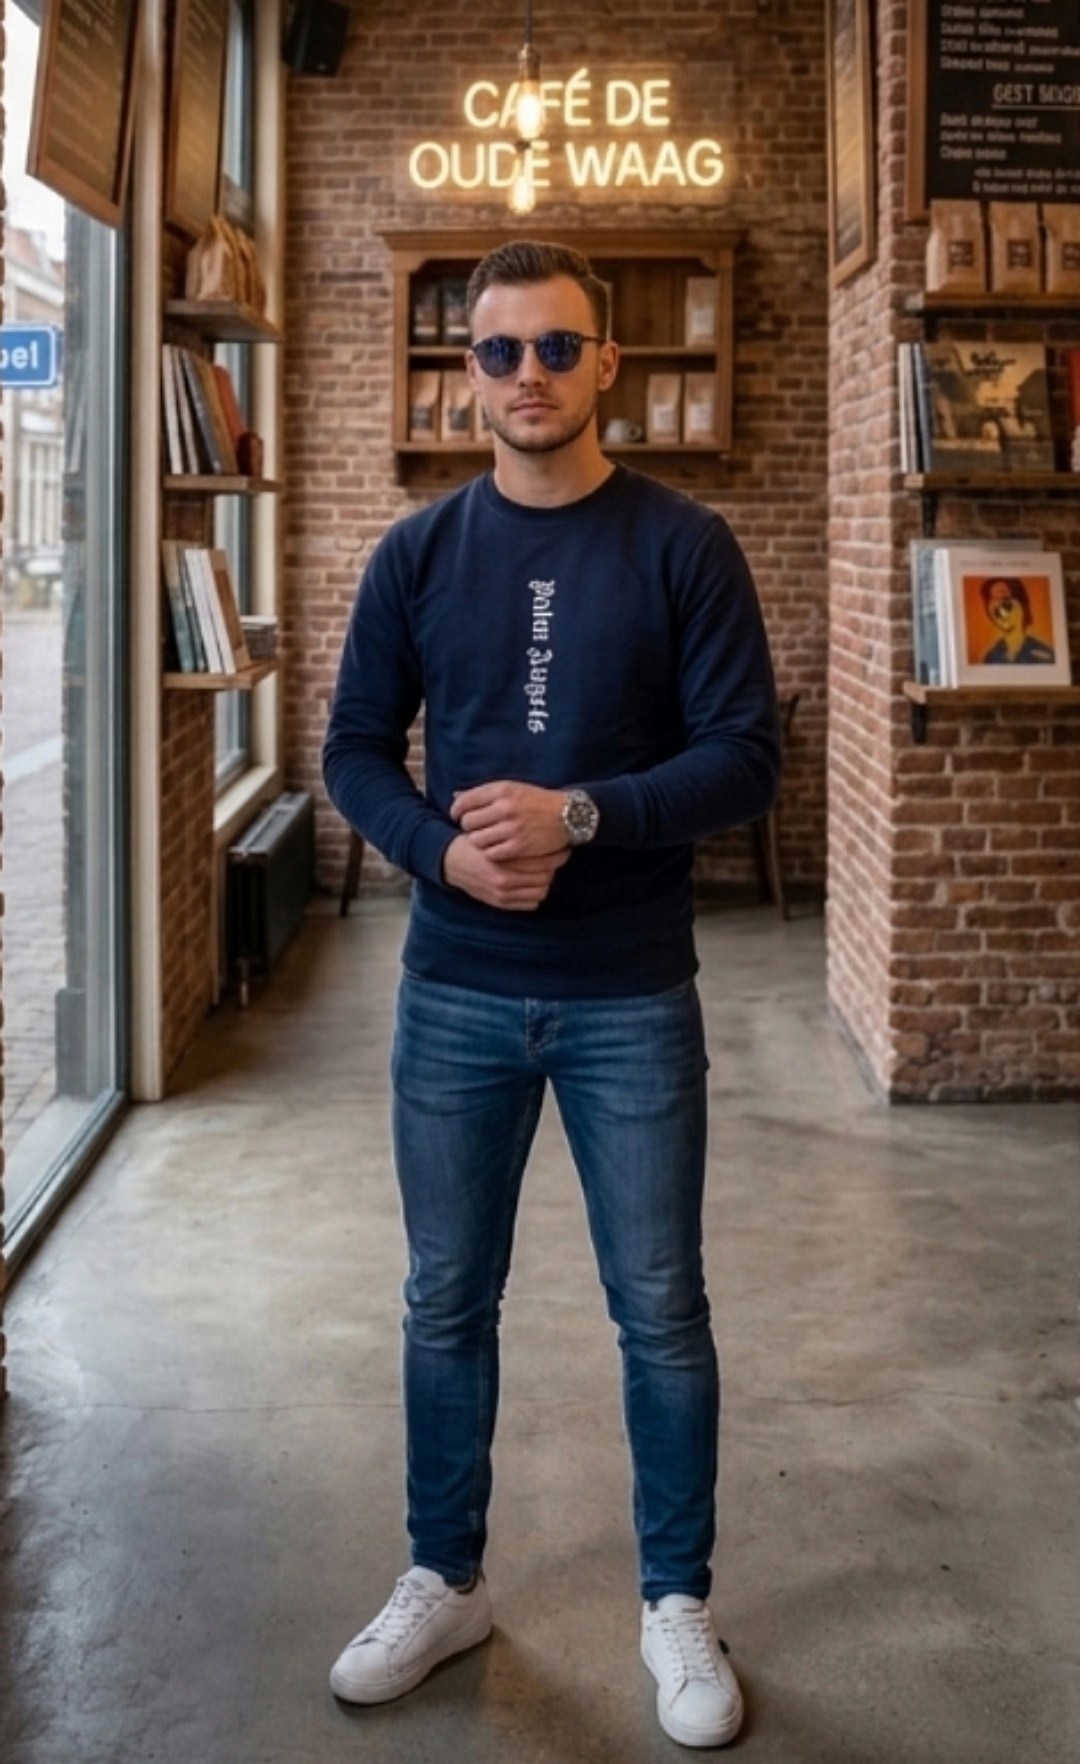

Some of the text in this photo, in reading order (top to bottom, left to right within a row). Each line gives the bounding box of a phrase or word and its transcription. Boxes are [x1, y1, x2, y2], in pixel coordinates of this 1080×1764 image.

[605, 78, 672, 127] DE
[408, 138, 724, 189] OUDE WAAG
